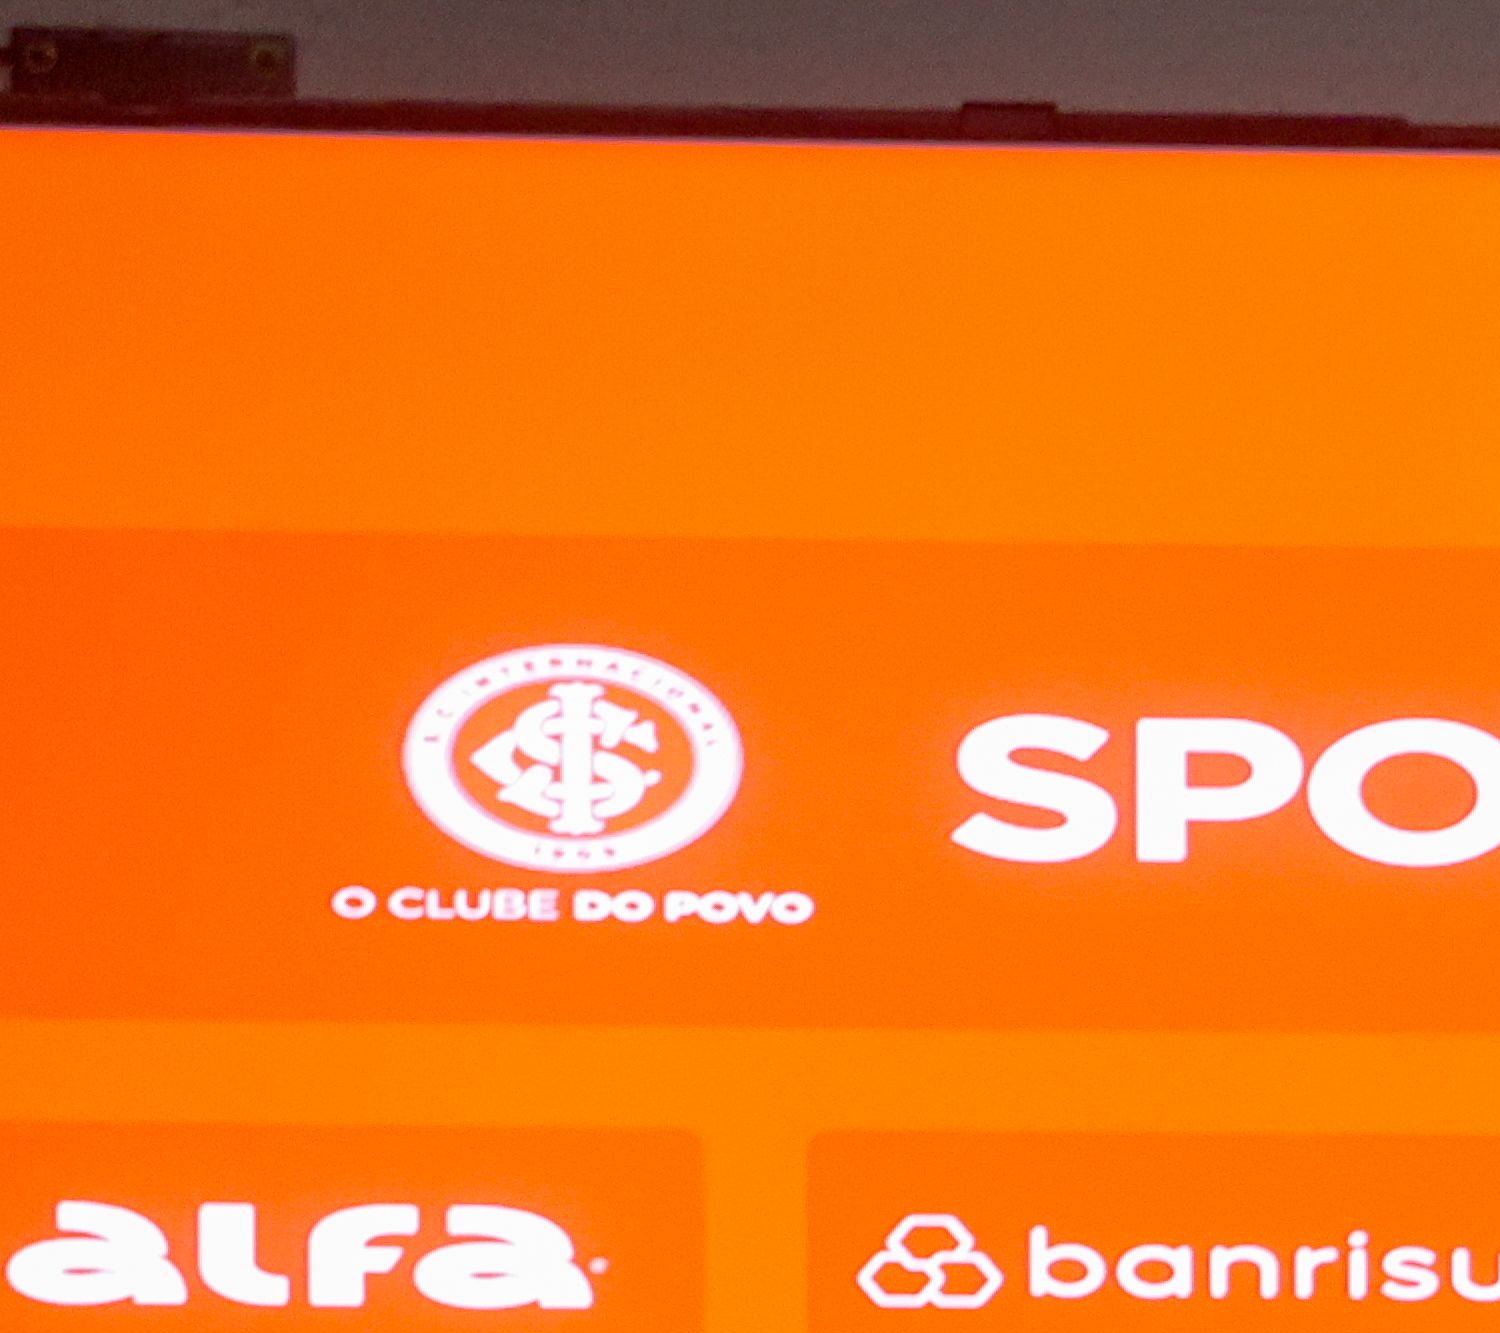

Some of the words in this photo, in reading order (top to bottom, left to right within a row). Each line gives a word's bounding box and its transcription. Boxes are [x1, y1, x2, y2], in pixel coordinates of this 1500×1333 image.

[332, 886, 377, 919] O
[388, 886, 559, 921] CLUBE
[573, 889, 655, 922] DO
[664, 890, 815, 924] POVO
[6, 1200, 608, 1310] alfa
